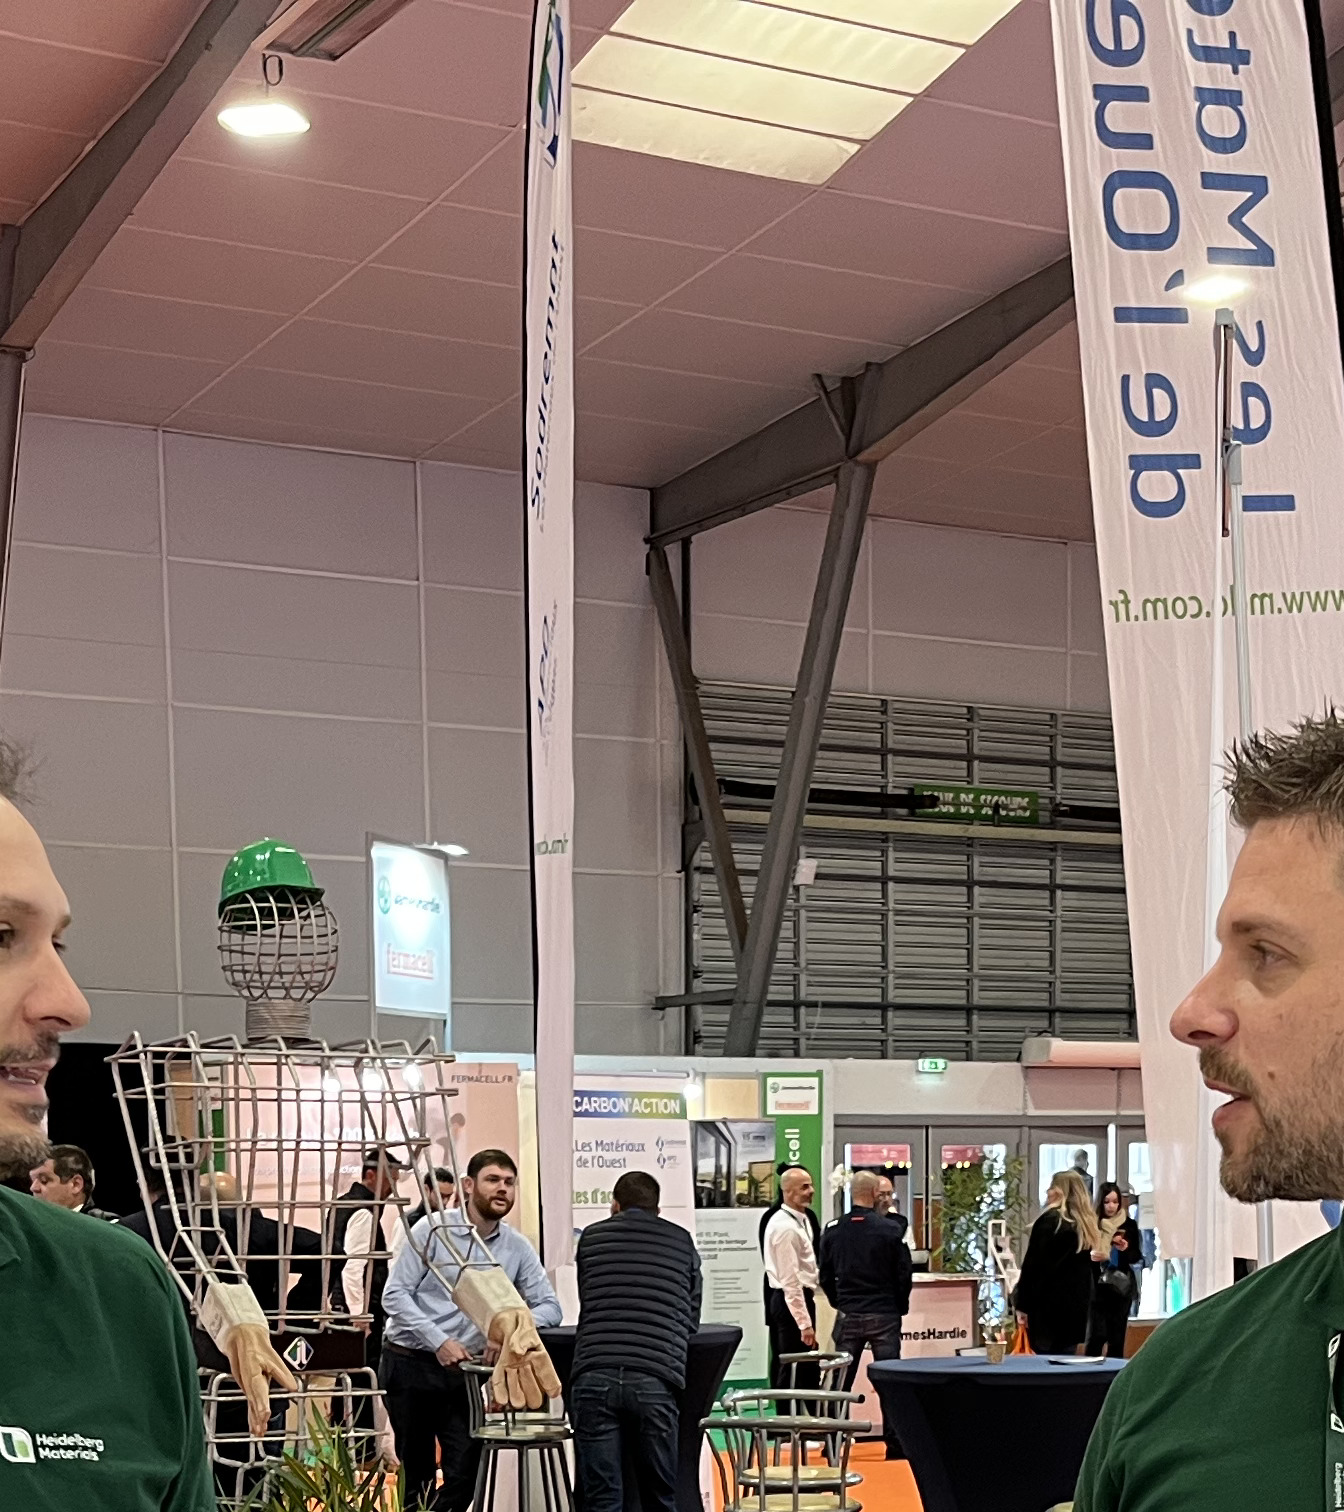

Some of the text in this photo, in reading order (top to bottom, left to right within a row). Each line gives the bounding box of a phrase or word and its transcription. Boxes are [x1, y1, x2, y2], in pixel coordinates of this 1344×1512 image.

[575, 1139, 646, 1153] Les Matériaux
[576, 1156, 589, 1168] de
[36, 1433, 105, 1452] Heidelberg
[38, 1447, 100, 1461] Materials
